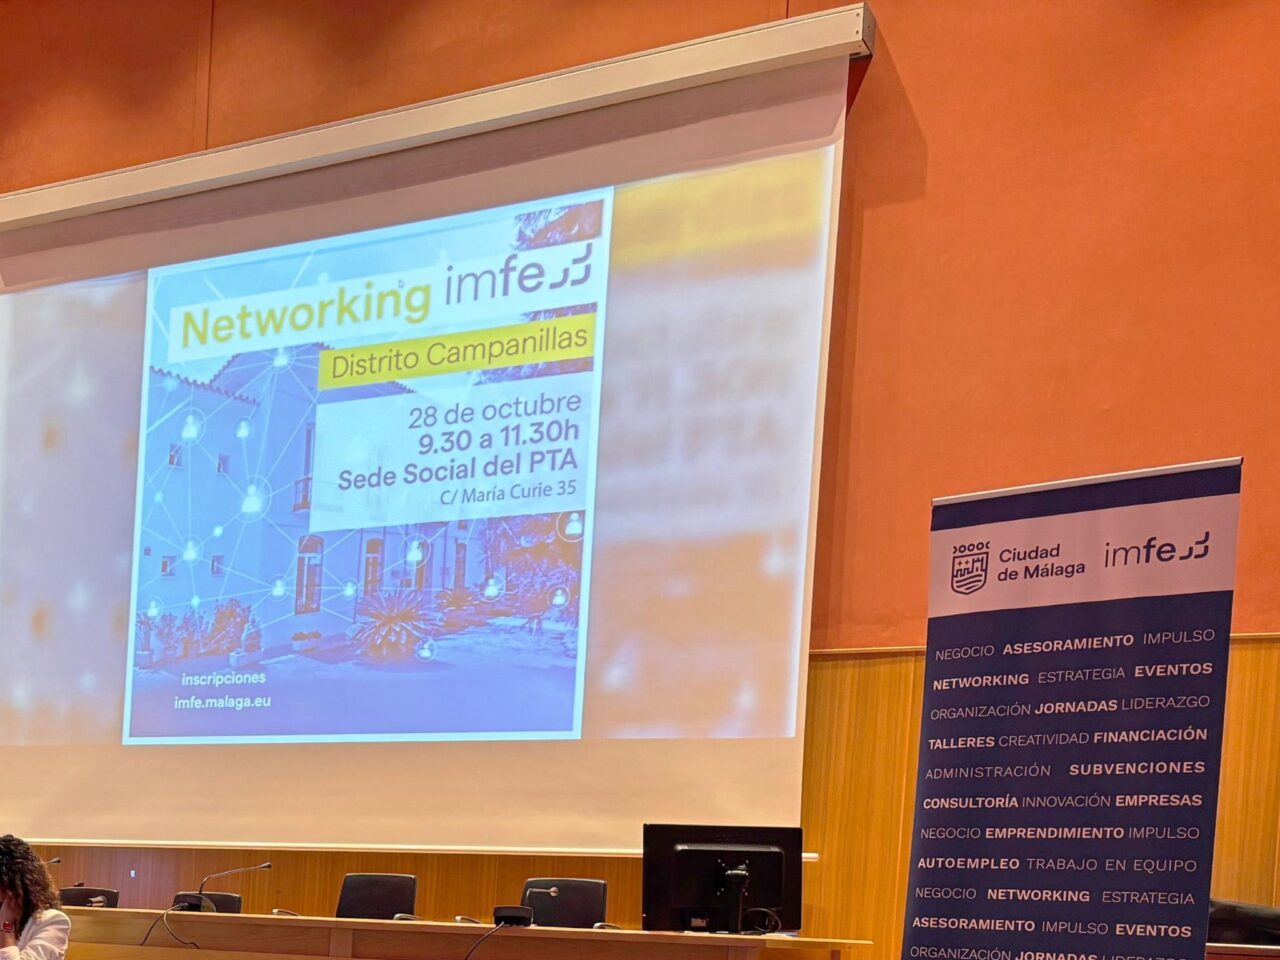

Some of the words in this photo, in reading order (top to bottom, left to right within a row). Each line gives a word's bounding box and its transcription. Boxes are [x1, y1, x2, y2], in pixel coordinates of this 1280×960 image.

[181, 280, 431, 348] Networking
[445, 253, 545, 305] imfe
[333, 348, 419, 379] Distrito
[426, 327, 587, 367] Campanillas
[409, 407, 437, 429] 28
[444, 402, 474, 425] de
[483, 393, 581, 420] octubre
[418, 430, 472, 455] 9.30
[479, 432, 493, 449] a
[501, 420, 579, 446] 11.30h
[338, 468, 396, 492] Sede
[403, 457, 476, 484] Social
[483, 454, 520, 478] del
[530, 449, 578, 472] PTA
[440, 488, 457, 505] C/
[462, 486, 505, 502] María
[510, 482, 552, 499] Curie
[558, 480, 576, 495] 35
[999, 544, 1060, 563] Ciudad
[1104, 537, 1176, 568] imfe
[997, 567, 1018, 582] de
[1024, 561, 1085, 579] Málaga
[936, 645, 995, 660] NEGOCIO
[1003, 635, 1134, 655] ASESORAMIENTO
[1143, 629, 1215, 645] IMPULSO
[182, 672, 266, 687] inscripciones
[933, 674, 1029, 690] NETWORKING
[1038, 667, 1125, 684] ESTRATEGIA
[1134, 662, 1213, 677] EVENTOS
[174, 694, 271, 710] imfe.malaga.eu
[930, 702, 1031, 720] ORGANIZACIÓN
[1035, 700, 1118, 714] JORNADAS
[1122, 695, 1210, 710] LIDERAZGO
[928, 736, 995, 749] TALLERES
[998, 733, 1089, 747] CREATIVIDAD
[1094, 726, 1208, 744] FINANCIACIÓN
[925, 764, 1051, 779] ADMINISTRACIÓN
[1070, 762, 1205, 775] SUBVENCIONES
[924, 793, 1018, 808] CONSULTORÍA
[1022, 794, 1111, 808] INNOVACIÓN
[1116, 794, 1202, 806] EMPRESAS
[920, 827, 981, 839] NEGOCIO
[986, 827, 1124, 839] EMPRENDIMIENTO
[1129, 827, 1200, 839] IMPULSO
[918, 857, 1020, 870] AUTOEMPLEO
[1027, 858, 1098, 871] TRABAJO
[1105, 859, 1126, 871] EN
[1134, 859, 1197, 874] EQUIPO
[915, 888, 977, 899] NEGOCIO
[987, 888, 1090, 902] NETWORKING
[1102, 891, 1194, 905] ESTRATEGIA
[912, 917, 1035, 932] ASESORAMIENTO
[1042, 921, 1108, 934] IMPULSO
[1116, 924, 1192, 938] EVENTOS
